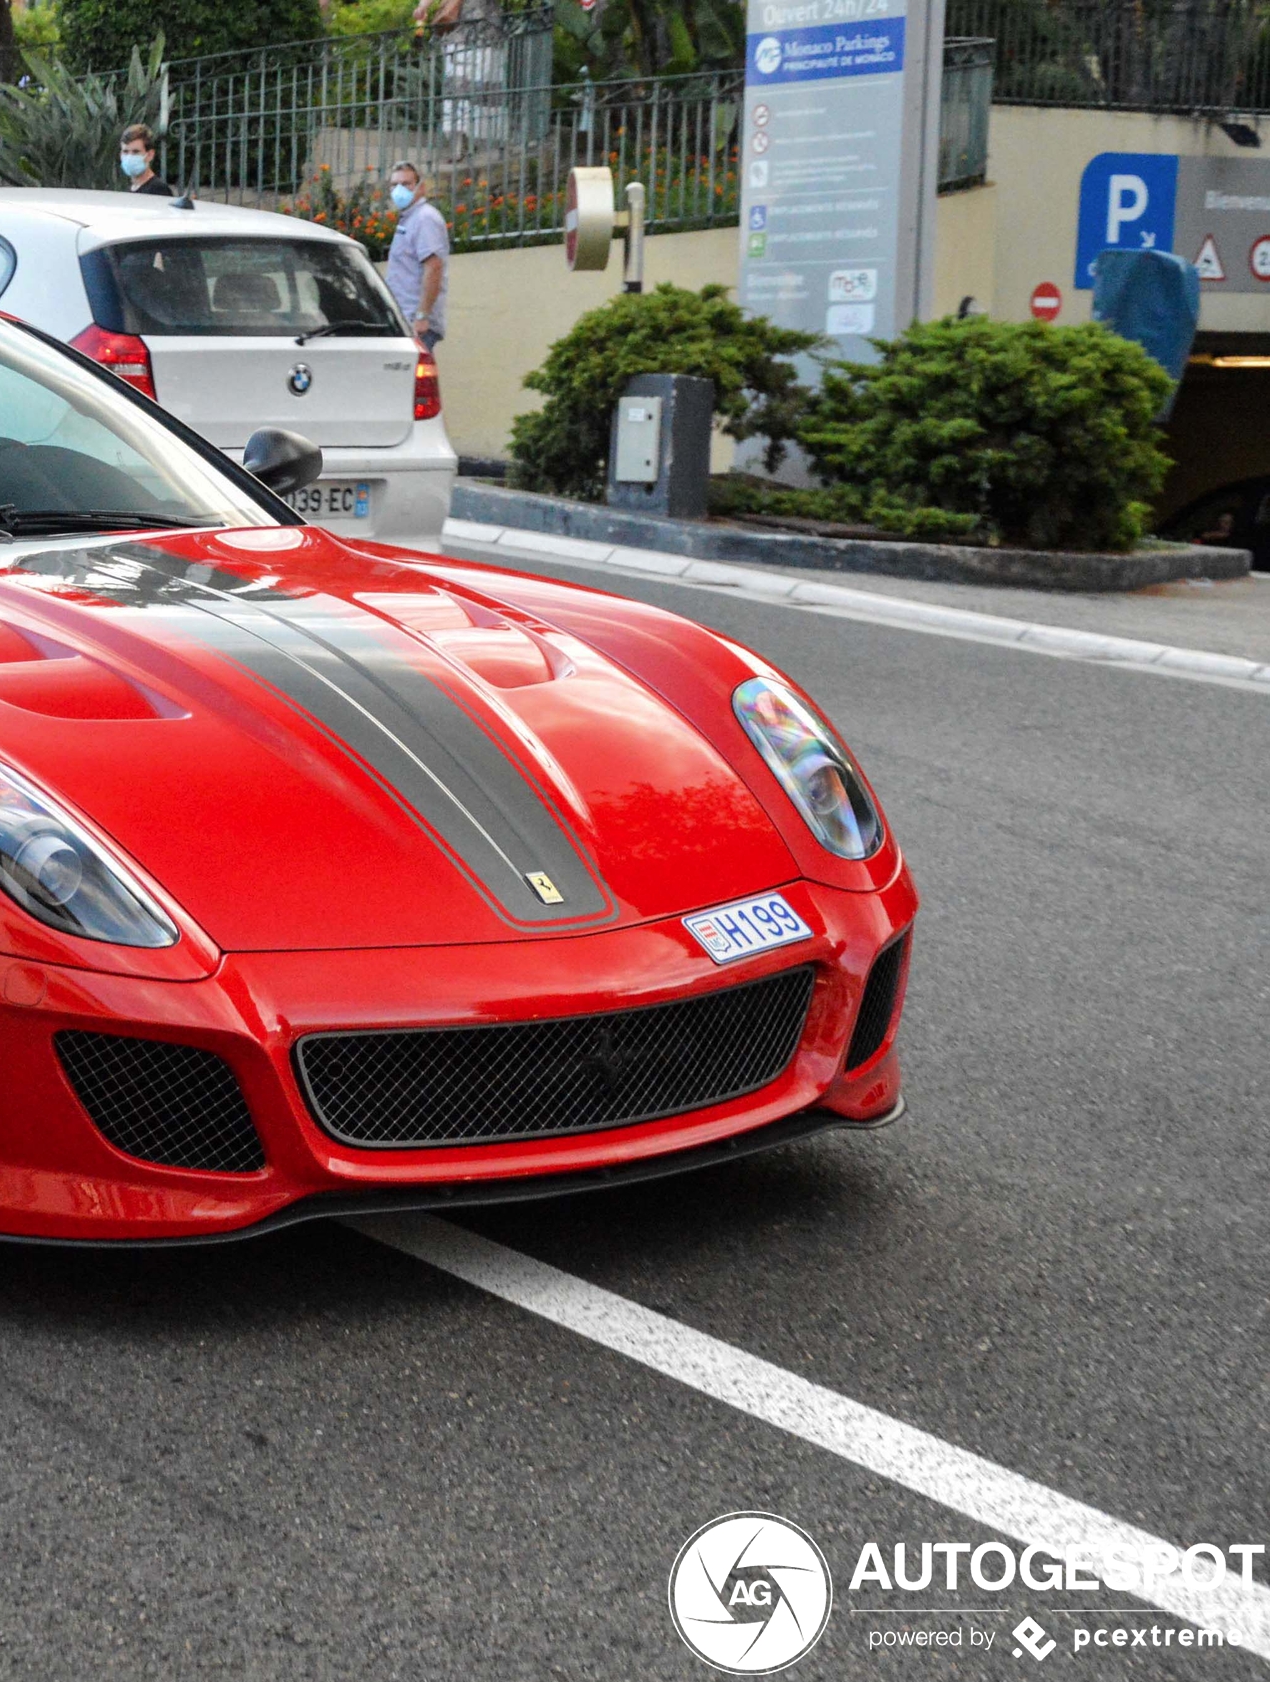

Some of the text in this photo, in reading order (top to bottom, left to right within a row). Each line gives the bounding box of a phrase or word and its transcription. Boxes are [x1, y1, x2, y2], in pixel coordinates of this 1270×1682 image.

[763, 3, 818, 26] Ouvert
[784, 41, 834, 57] Monaco
[835, 34, 890, 53] Parkings
[1106, 174, 1149, 244] P
[714, 901, 799, 948] H199
